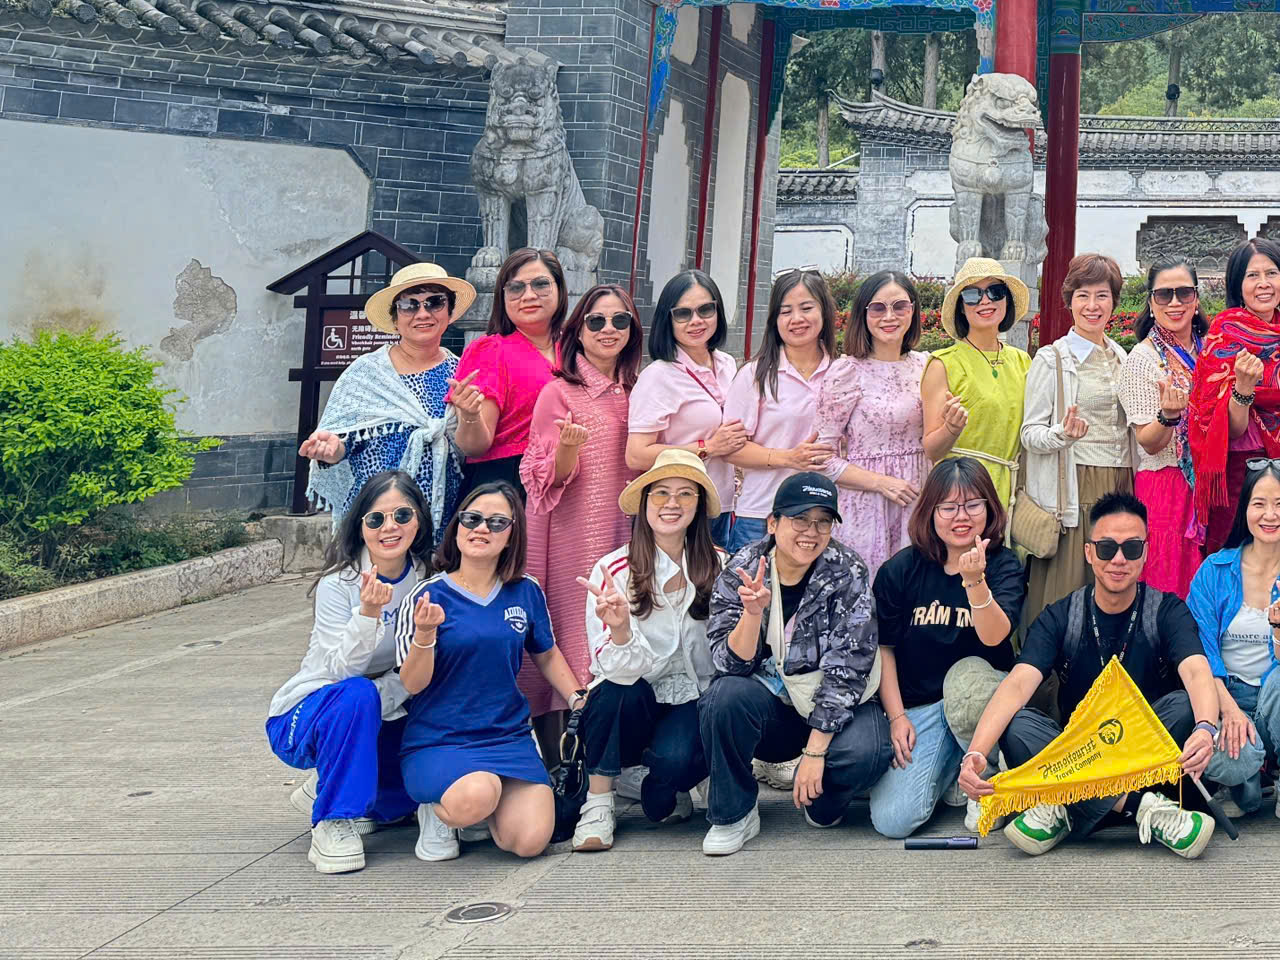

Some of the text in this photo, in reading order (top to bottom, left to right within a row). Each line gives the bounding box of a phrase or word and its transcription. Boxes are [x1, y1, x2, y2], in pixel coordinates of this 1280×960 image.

[1038, 738, 1096, 779] Hanoitourist
[1055, 751, 1102, 781] Travel Company
